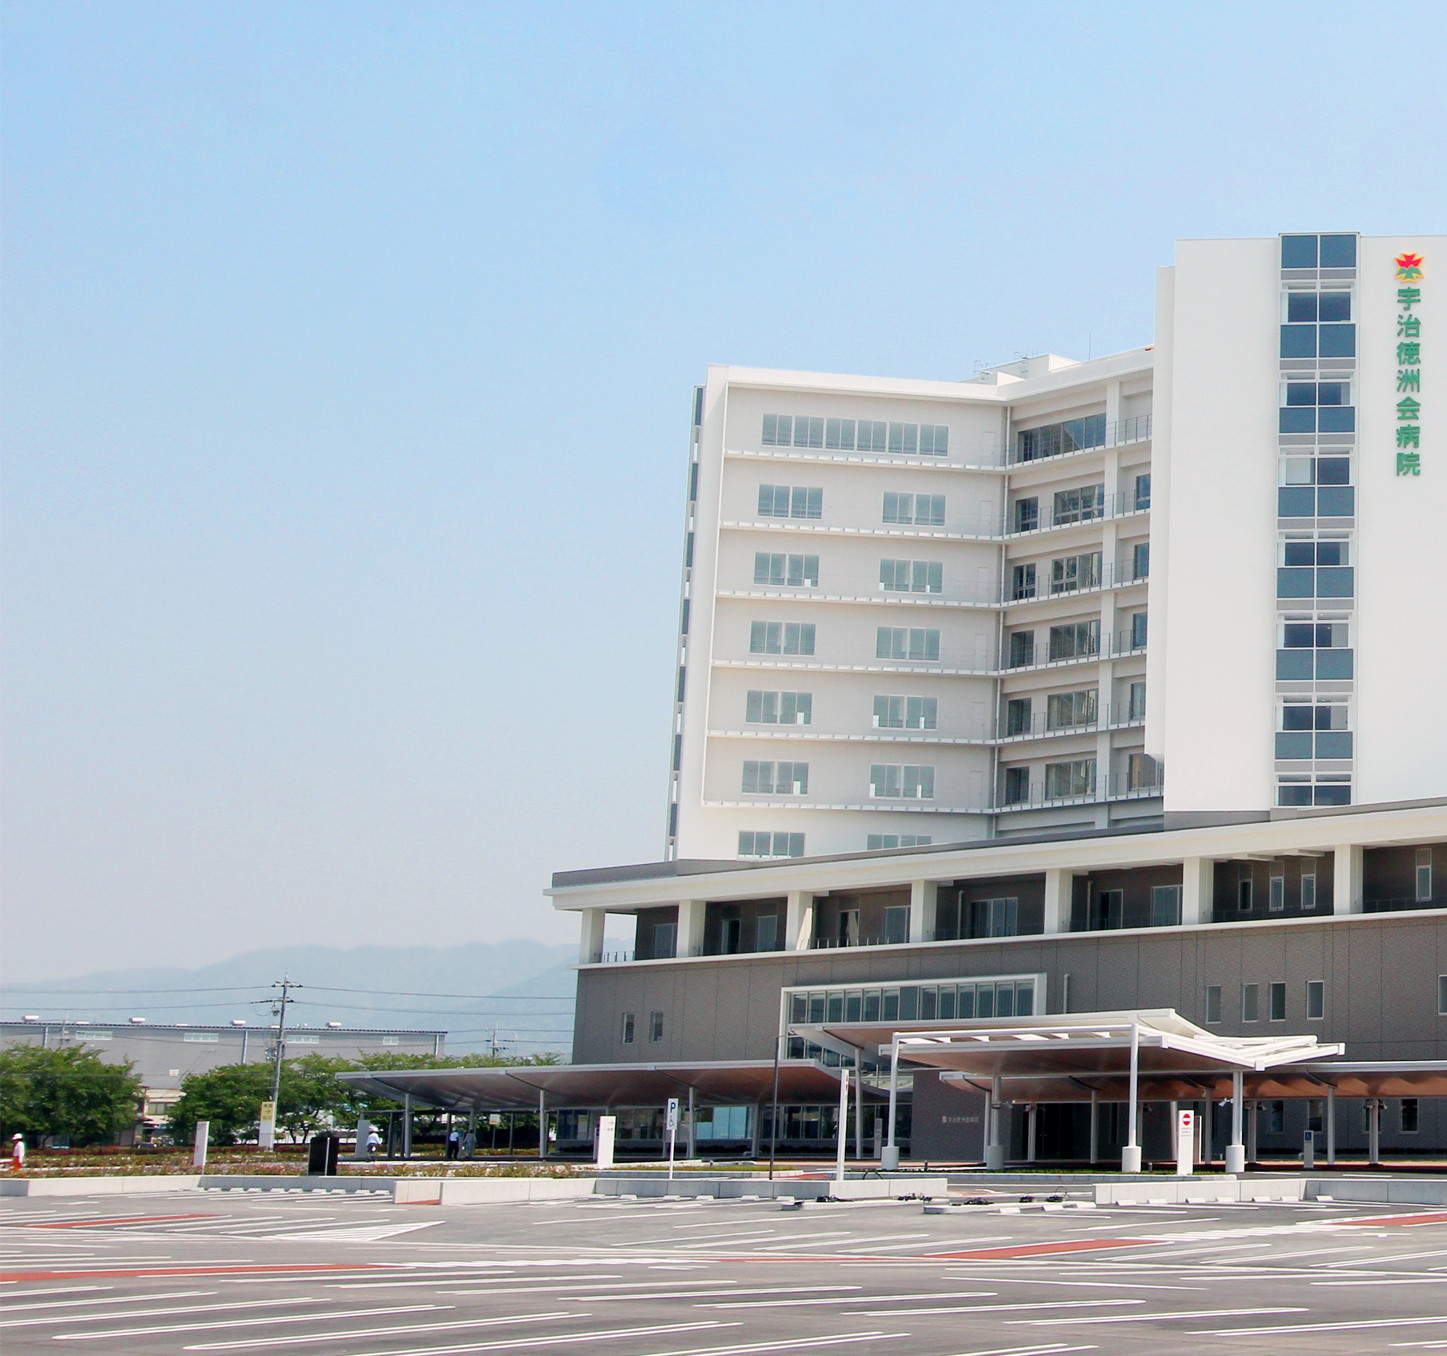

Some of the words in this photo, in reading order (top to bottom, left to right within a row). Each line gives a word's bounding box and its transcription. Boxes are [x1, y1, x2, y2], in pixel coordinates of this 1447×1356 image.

[1396, 287, 1421, 477] 宇治徳洲会病院
[670, 1102, 676, 1113] P
